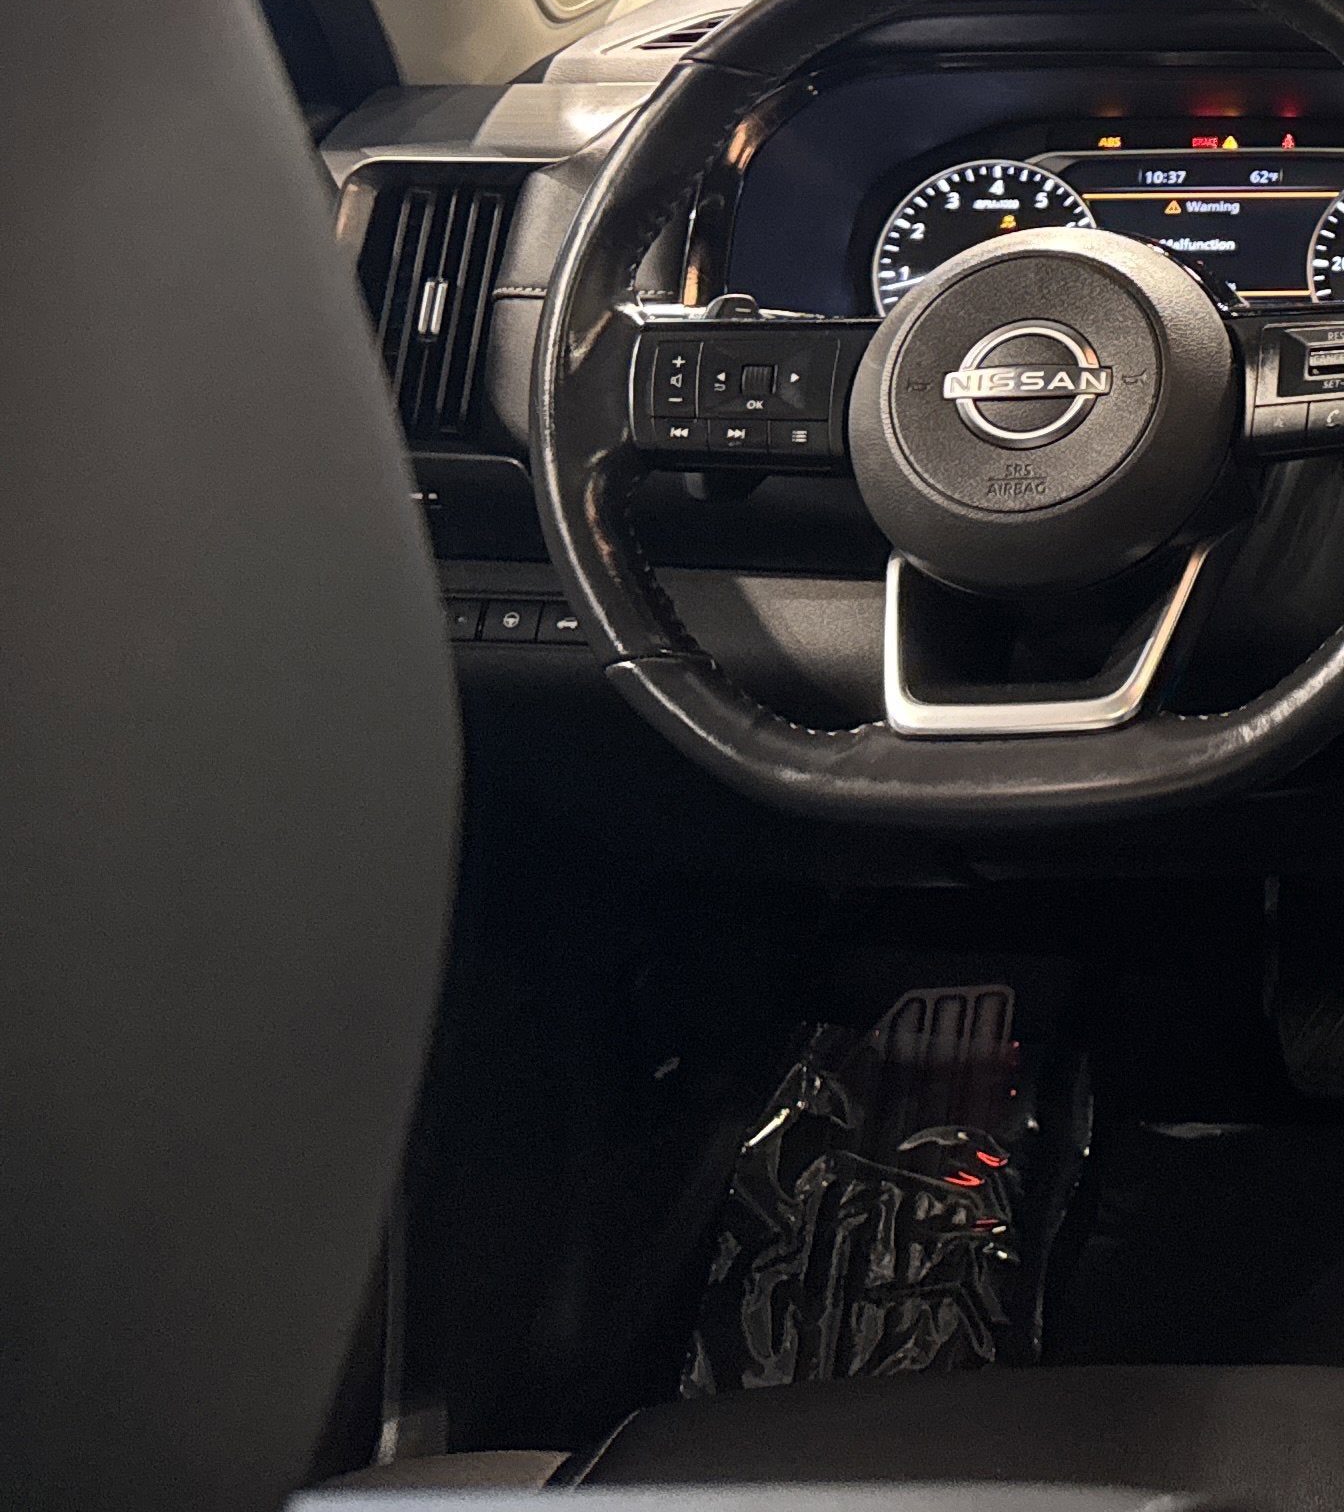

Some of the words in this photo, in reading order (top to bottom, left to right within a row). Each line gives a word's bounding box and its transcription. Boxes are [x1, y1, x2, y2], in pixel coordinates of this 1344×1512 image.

[1098, 136, 1122, 148] ABS
[1144, 170, 1187, 184] 10:37
[988, 179, 1005, 196] 4
[944, 191, 960, 210] 3
[1034, 191, 1049, 209] 5
[1185, 201, 1241, 215] Warning
[909, 222, 926, 240] 2
[899, 265, 910, 281] 1
[950, 371, 1108, 392] NISSAN
[746, 399, 764, 410] OK
[1005, 464, 1033, 476] SRS
[986, 480, 1047, 496] AIRBAG
